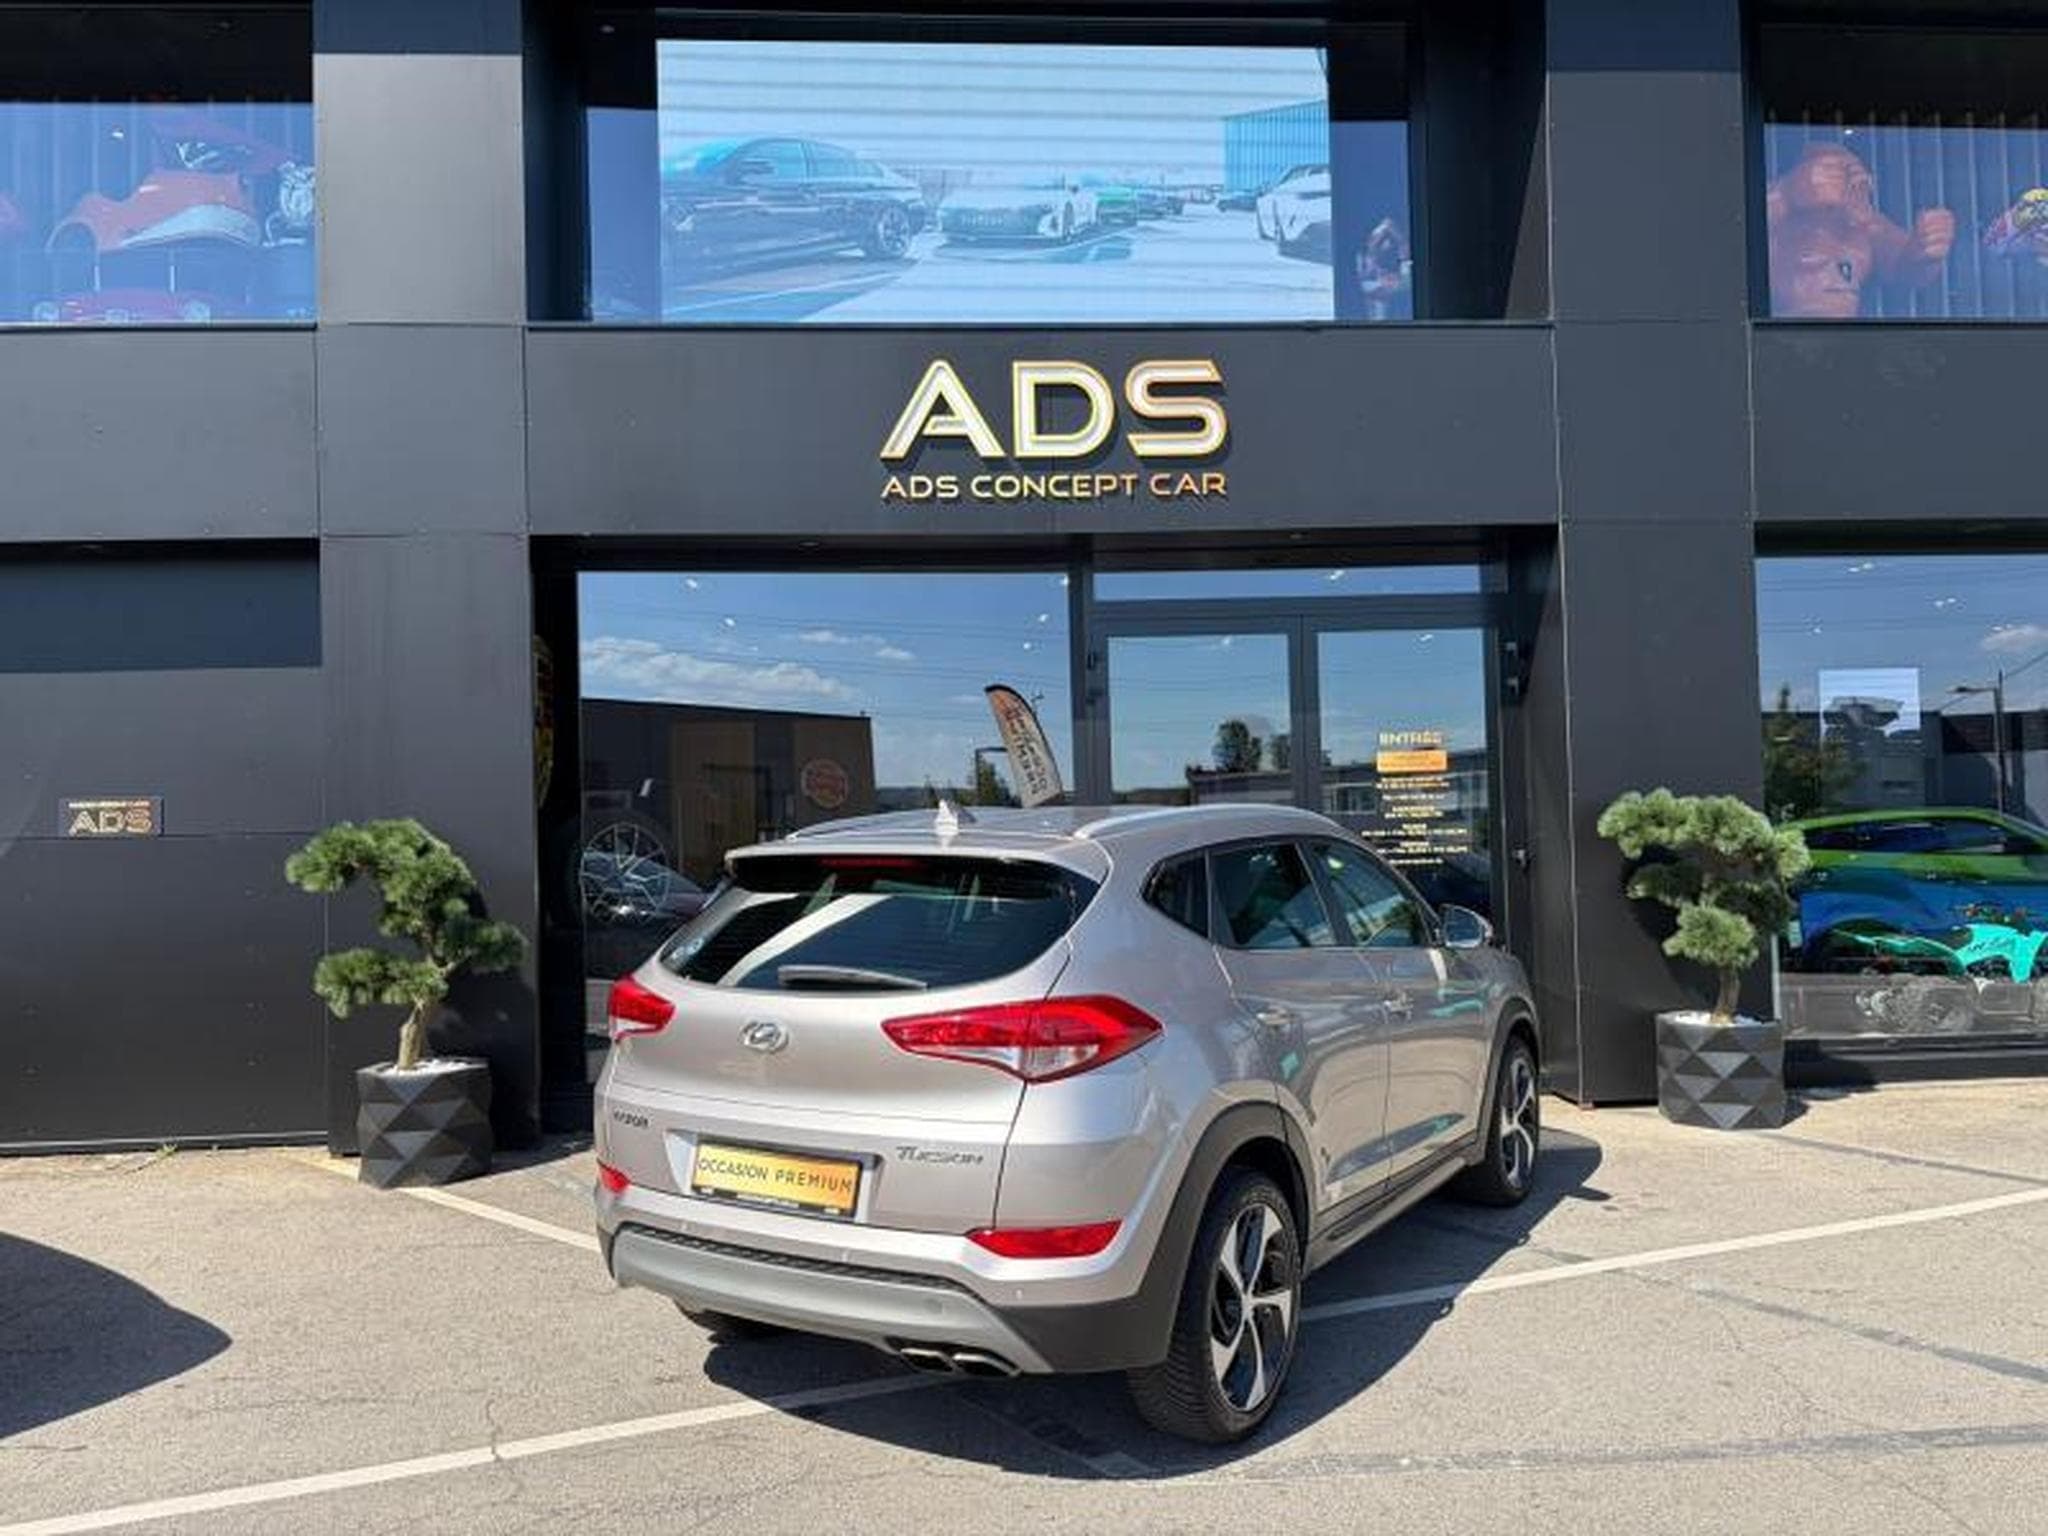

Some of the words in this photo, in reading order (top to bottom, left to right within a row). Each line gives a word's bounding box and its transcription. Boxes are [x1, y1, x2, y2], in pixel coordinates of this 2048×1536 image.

[880, 359, 1228, 458] ADS
[881, 475, 959, 498] ADS
[970, 474, 1139, 499] CONCEPT
[1150, 472, 1226, 496] CAR
[68, 809, 153, 836] ADS
[698, 1157, 769, 1181] OCCASION
[774, 1168, 853, 1194] PREMIUM
